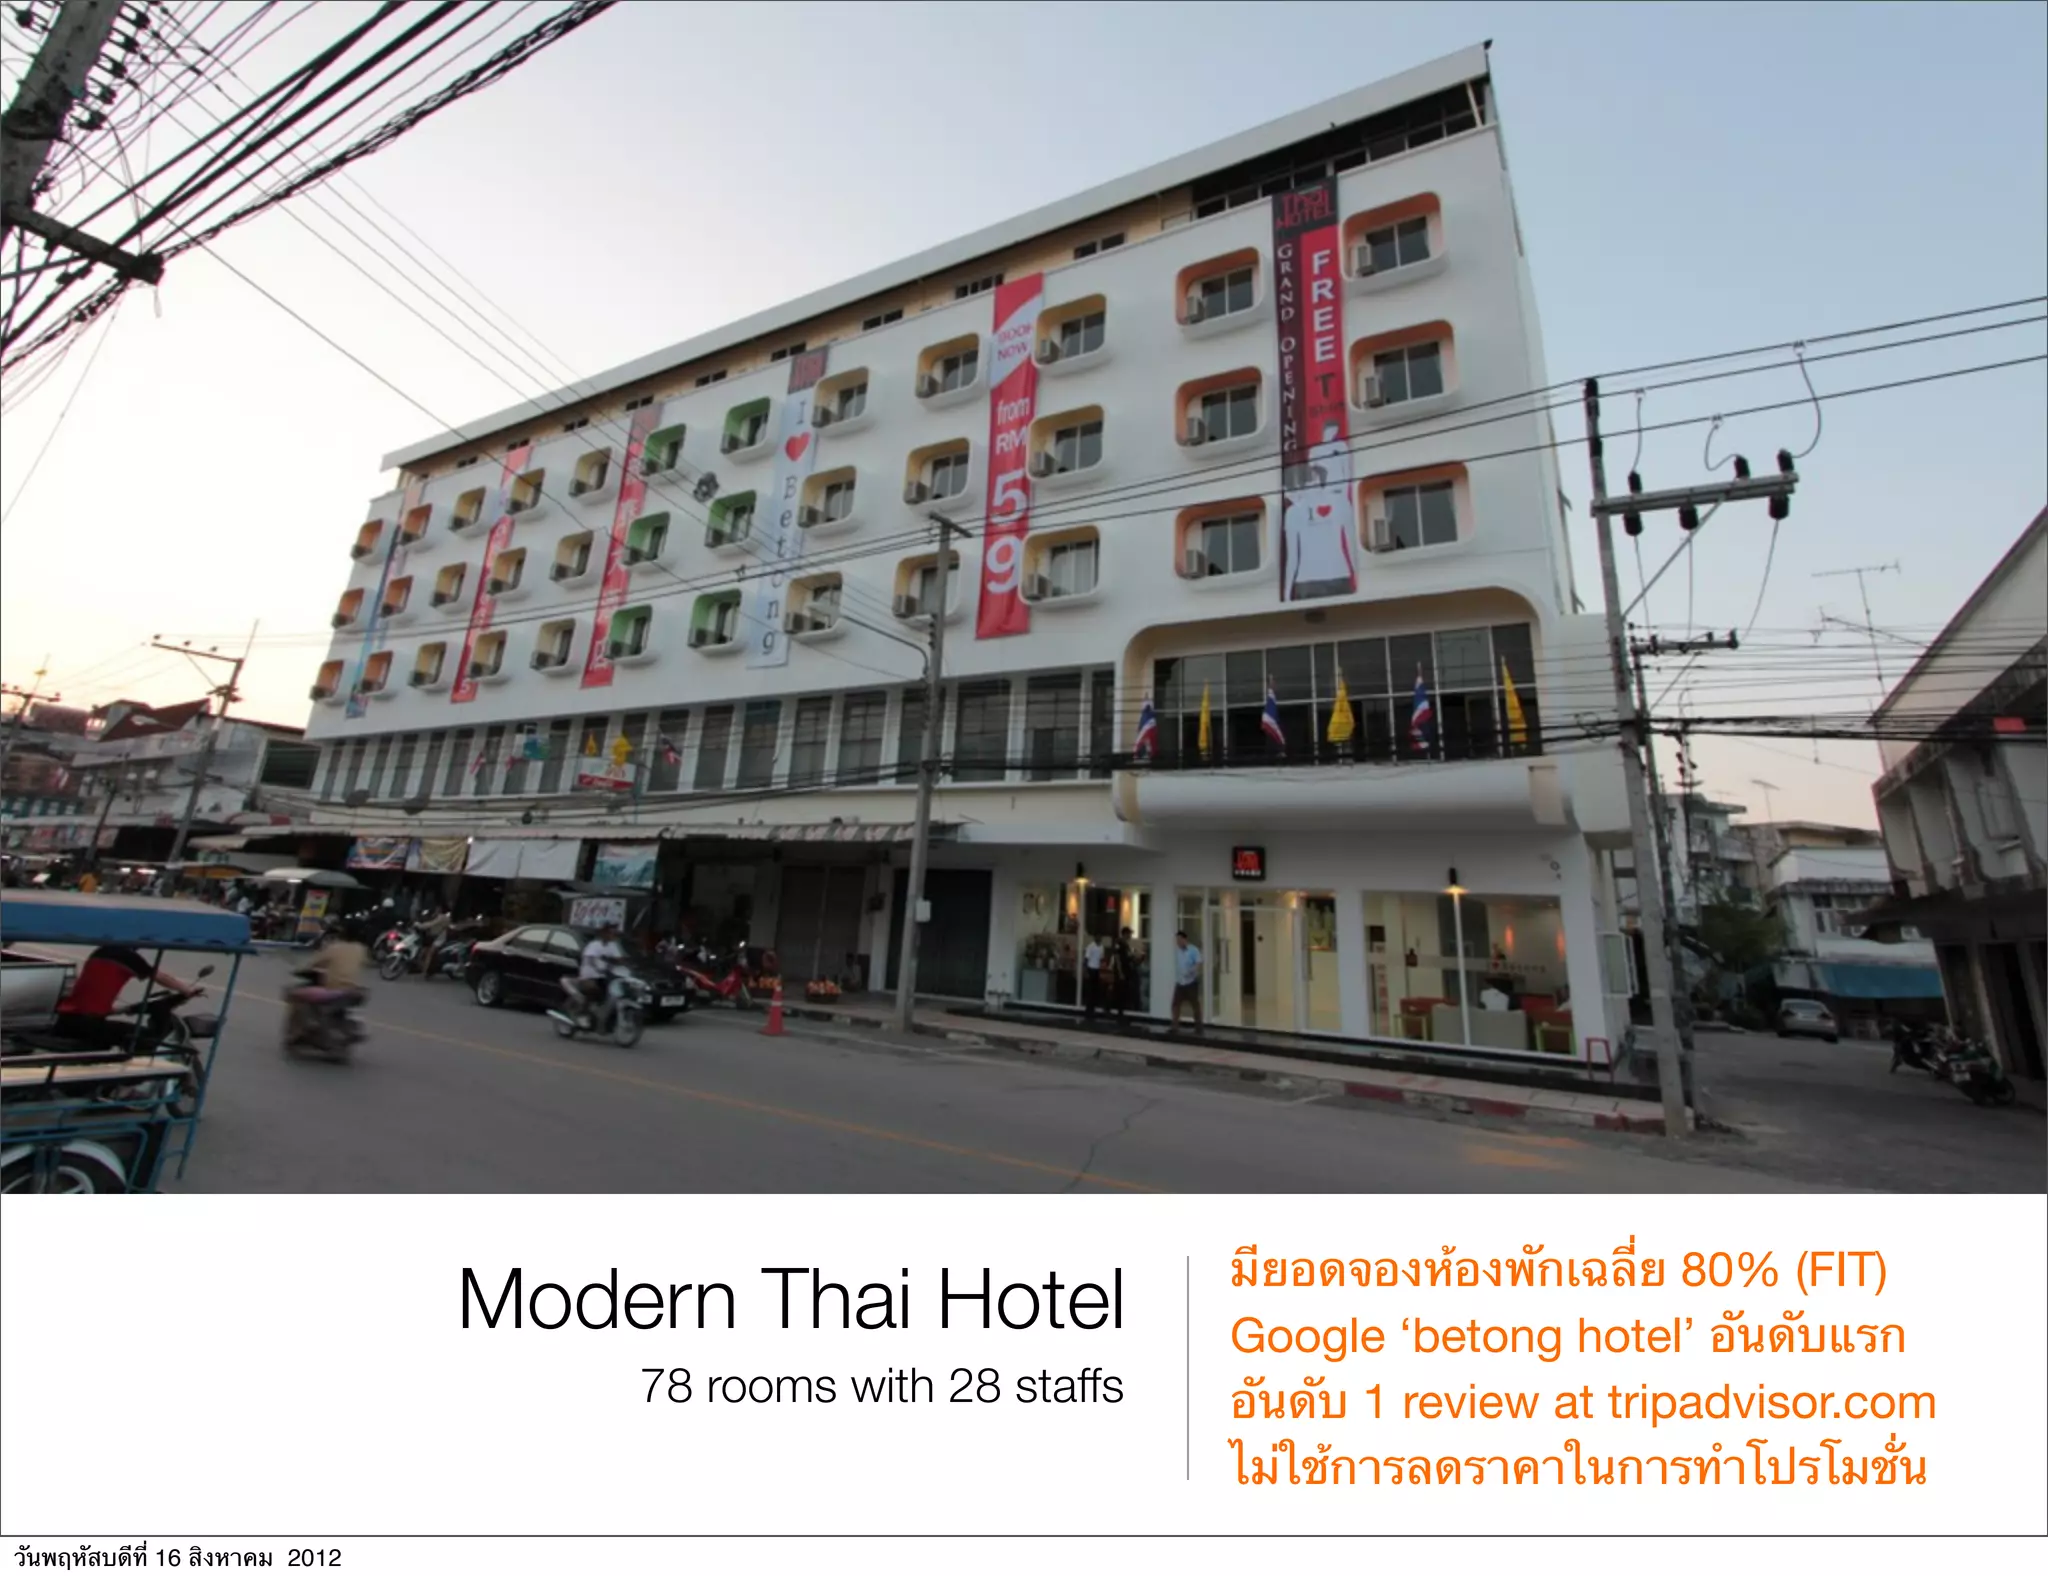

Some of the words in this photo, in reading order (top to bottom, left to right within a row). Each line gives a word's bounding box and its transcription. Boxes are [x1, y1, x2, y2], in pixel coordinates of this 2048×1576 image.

[1277, 244, 1295, 322] GRAND
[1311, 249, 1336, 363] FREE
[997, 341, 1028, 362] NOW
[1280, 337, 1297, 453] OPENING
[995, 425, 1027, 455] RM
[996, 398, 1030, 426] from
[762, 475, 798, 656] Betong
[986, 468, 1027, 593] 59
